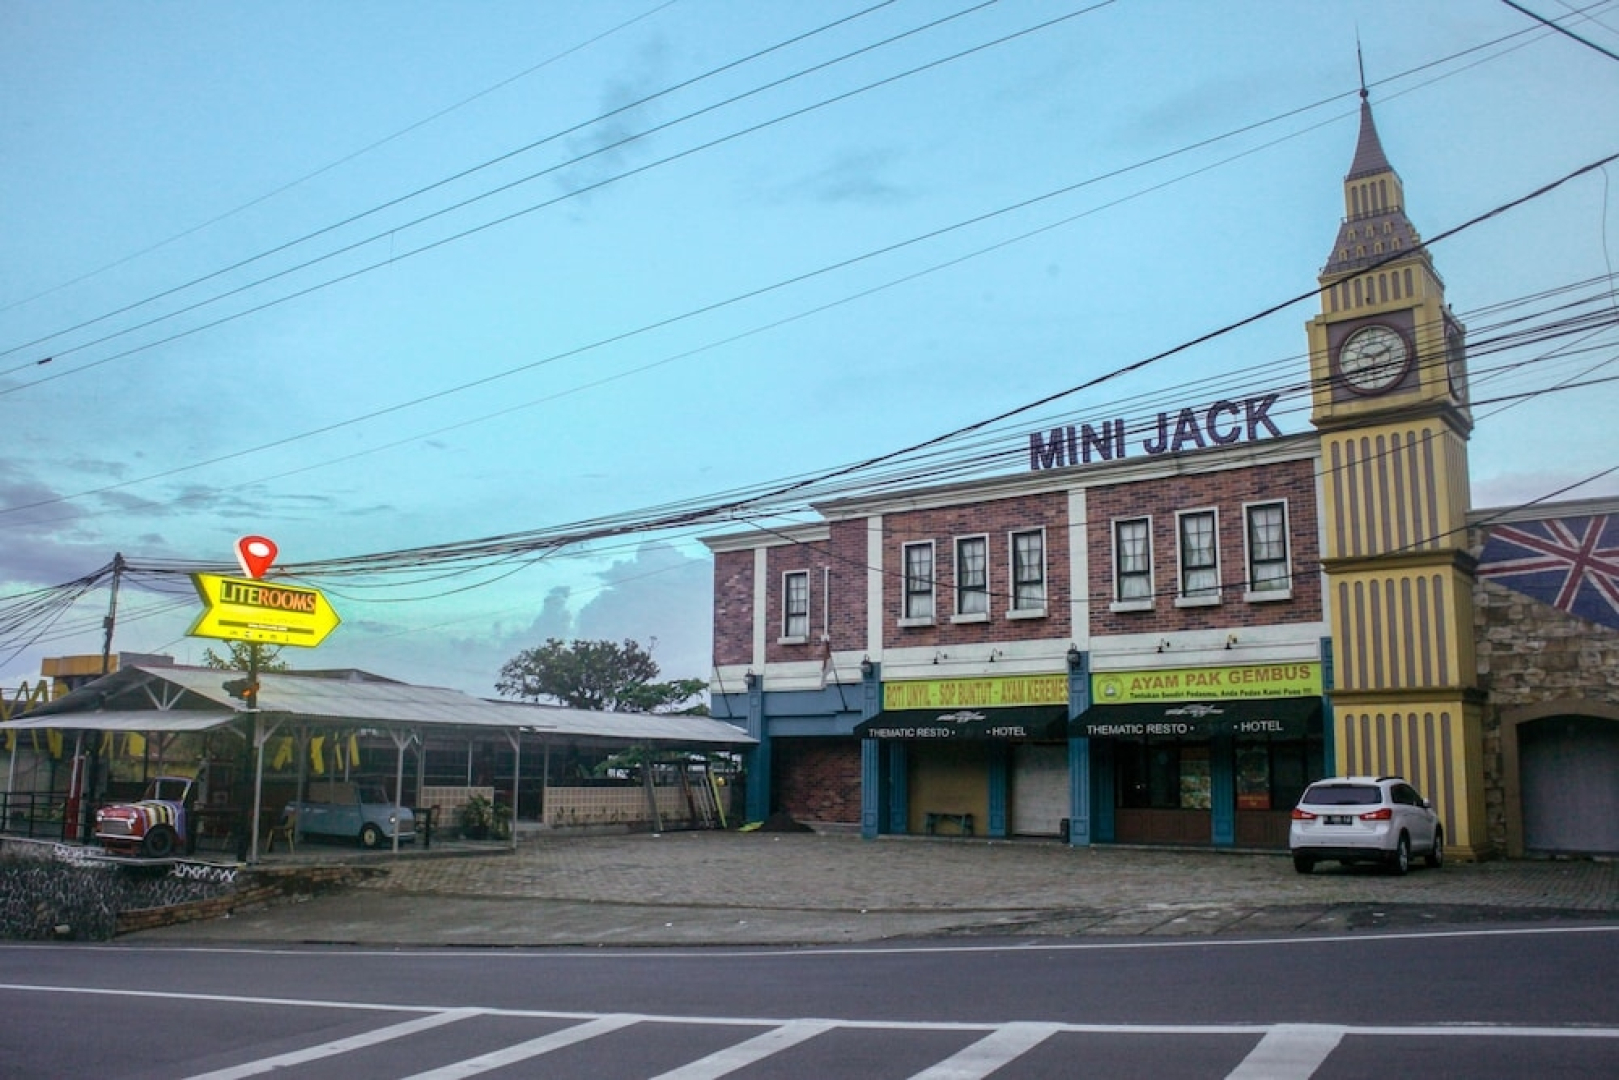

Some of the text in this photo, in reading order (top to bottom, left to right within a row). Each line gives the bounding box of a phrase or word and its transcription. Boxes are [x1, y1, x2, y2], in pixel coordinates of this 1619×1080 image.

[1029, 393, 1283, 471] MINI JACK
[220, 582, 315, 611] LITEROOMS
[1130, 665, 1311, 691] AYAM PAK GEMBUS
[992, 726, 1027, 737] HOTEL
[1086, 723, 1188, 735] THEMATIC RESTO
[1241, 720, 1284, 732] HOTEL
[868, 727, 950, 738] THEMATIC RESTO
